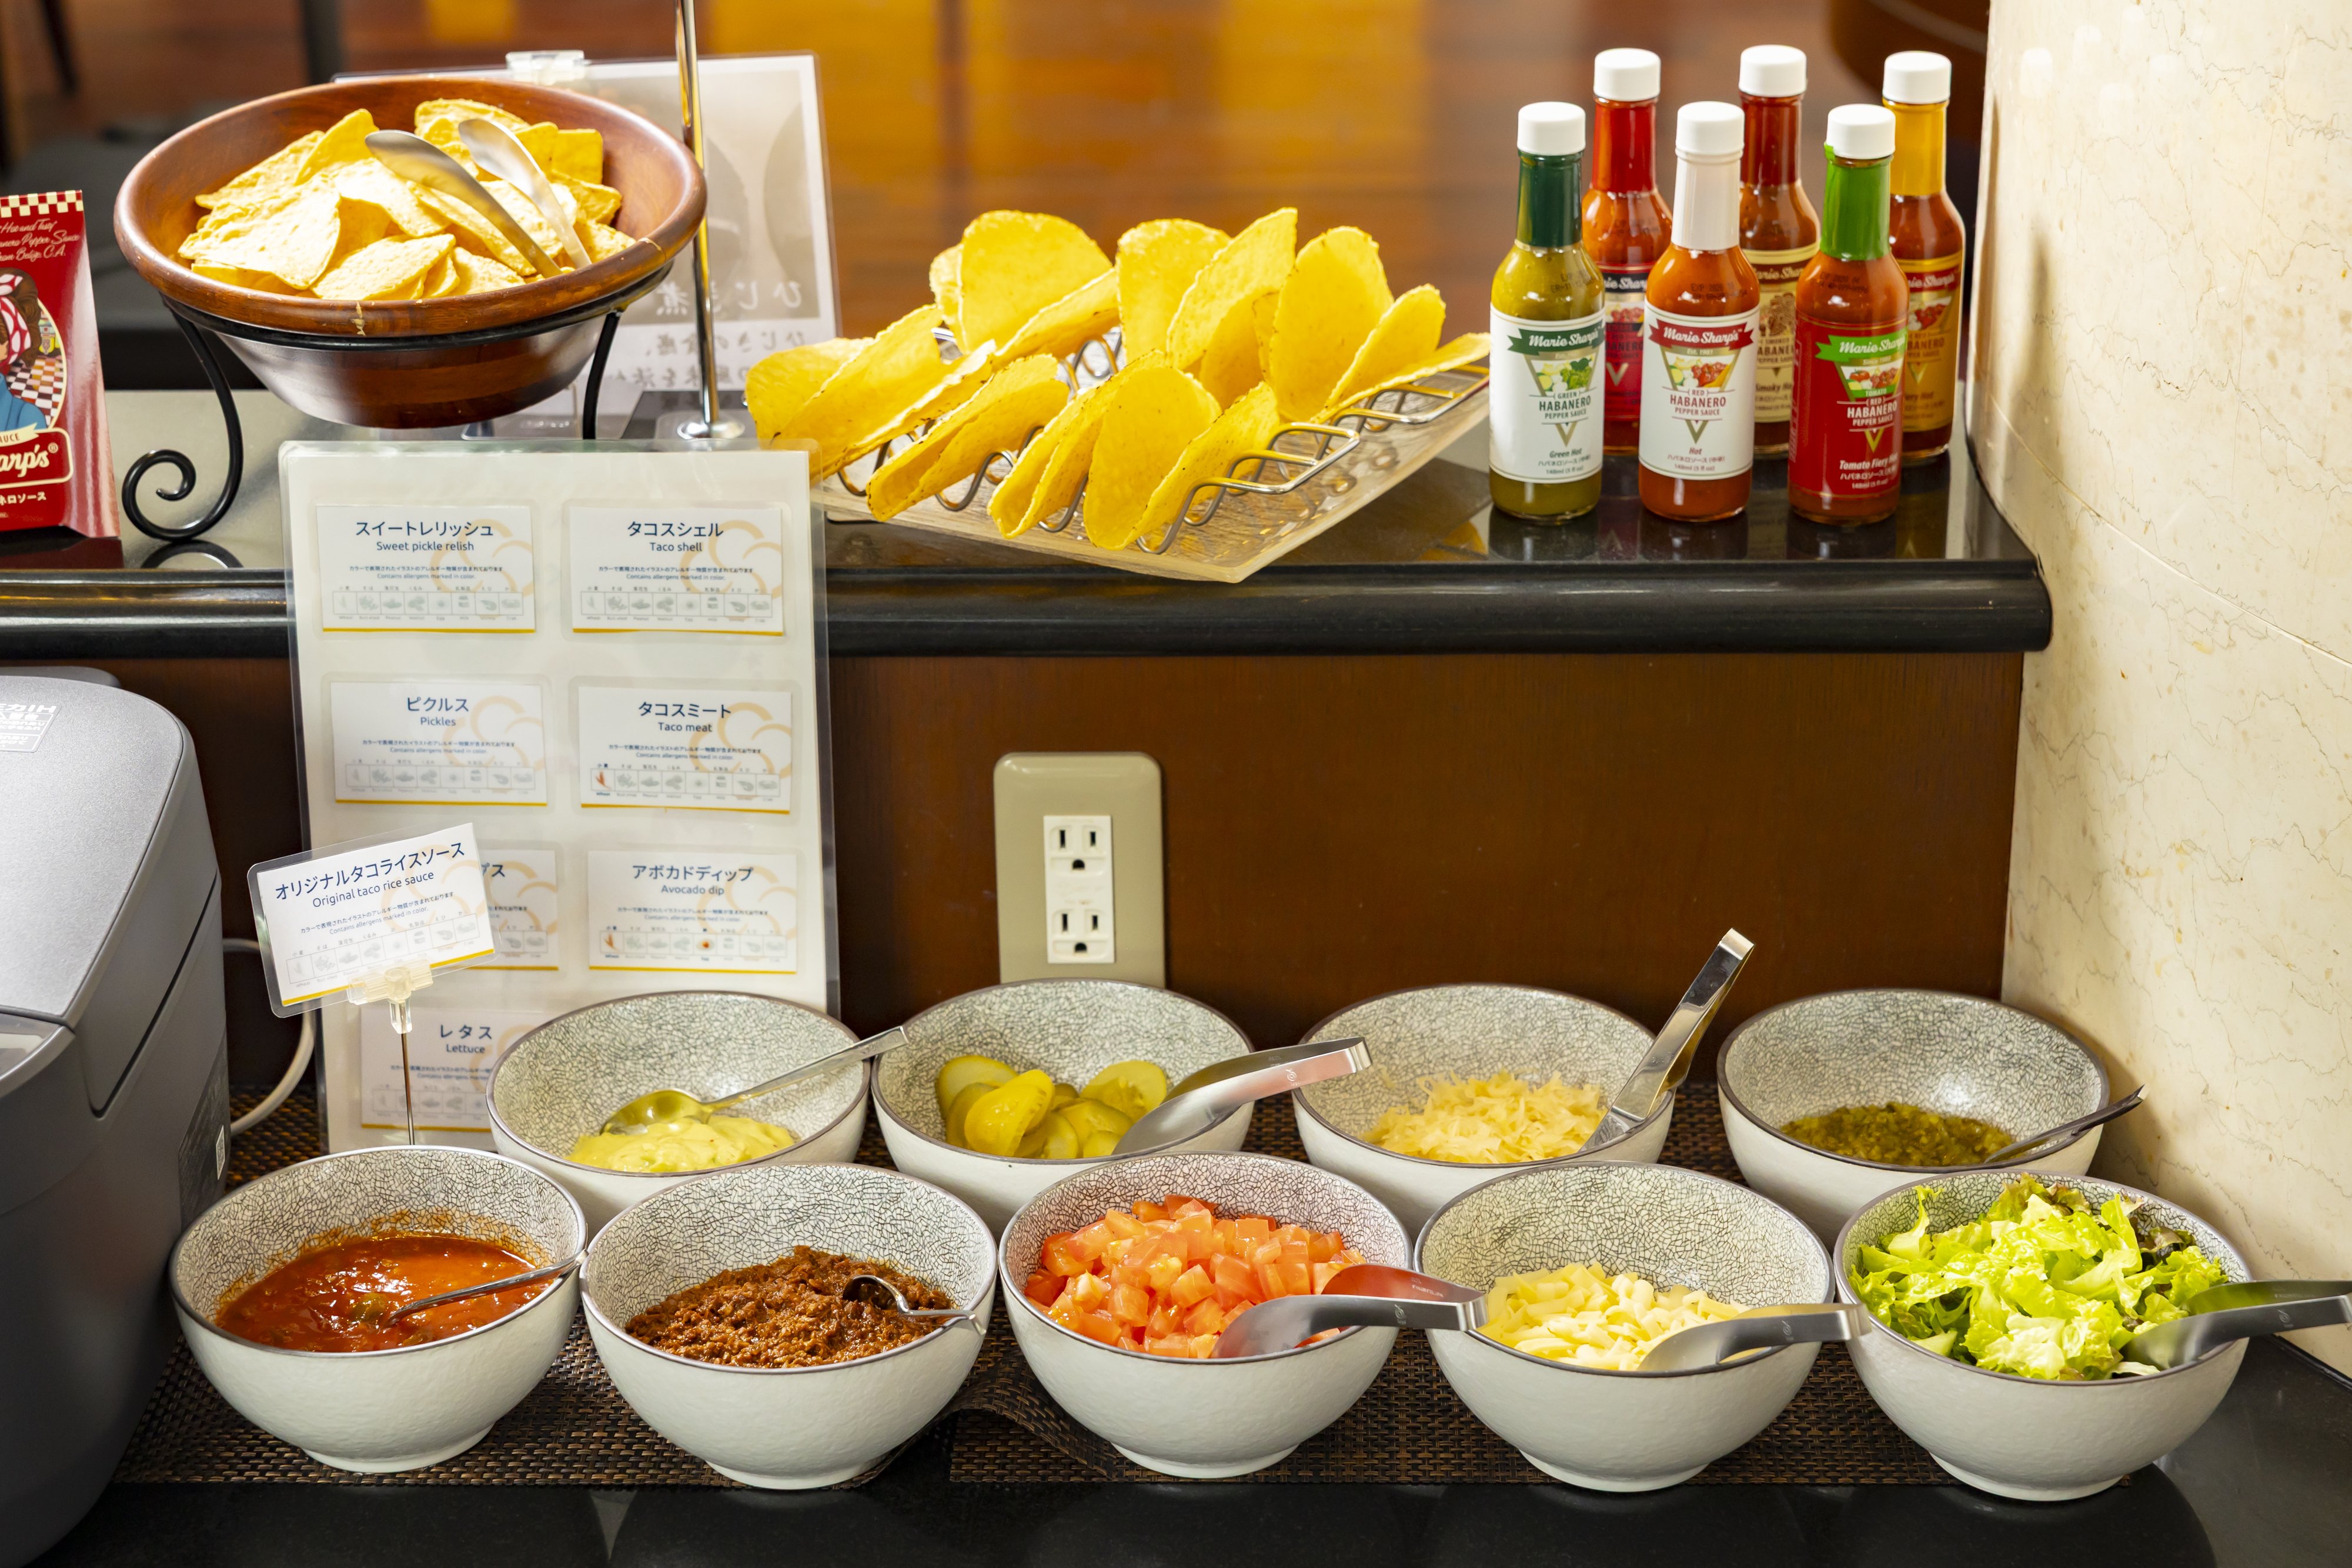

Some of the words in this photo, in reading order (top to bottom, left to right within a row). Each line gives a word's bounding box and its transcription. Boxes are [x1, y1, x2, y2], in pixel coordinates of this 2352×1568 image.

[1605, 278, 1618, 289] rie
[1907, 277, 1923, 288] rie
[1529, 335, 1568, 347] Marie
[1663, 326, 1700, 343] Marie
[1700, 330, 1739, 346] Sharp's
[1839, 341, 1878, 353] Marie
[1558, 391, 1577, 399] GREEN
[1669, 394, 1727, 407] HABANERO
[1539, 395, 1591, 412] HABANERO
[1847, 400, 1897, 419] HABANERO
[1570, 409, 1586, 417] SAUCE
[1675, 407, 1699, 415] PEPPER
[1852, 416, 1876, 426] PEPPER
[1877, 413, 1893, 424] SAUCE
[1549, 450, 1569, 459] Green
[1839, 460, 1870, 470] Tomato
[356, 521, 494, 537] スイートレリッシュ
[627, 521, 724, 537] タコスシェル
[376, 541, 409, 551] Sweet
[412, 541, 442, 553] pickle
[446, 541, 474, 551] relish
[650, 542, 674, 551] Taco
[677, 541, 703, 552] shell
[407, 696, 469, 712] ピクルス
[639, 701, 731, 718] タコスミート
[420, 716, 456, 727] Pickles
[658, 722, 683, 732] Taco
[685, 723, 713, 733] meat
[275, 842, 465, 900] オリジナルタコライスソース
[633, 865, 754, 881] アボカドディップ
[313, 889, 355, 908] Original
[358, 884, 380, 897] taco
[383, 878, 402, 892] rice
[405, 871, 435, 886] sauce
[661, 884, 705, 894] Avocado
[709, 885, 724, 895] dip
[300, 891, 454, 934] カラーで表現されたイラストのアレルギー物質が含まれております
[329, 925, 355, 935] Contains
[356, 918, 382, 930] allergens
[383, 912, 405, 921] marked
[413, 906, 429, 915] color.
[440, 1025, 492, 1039] レタス
[446, 1044, 485, 1054] Lettuce
